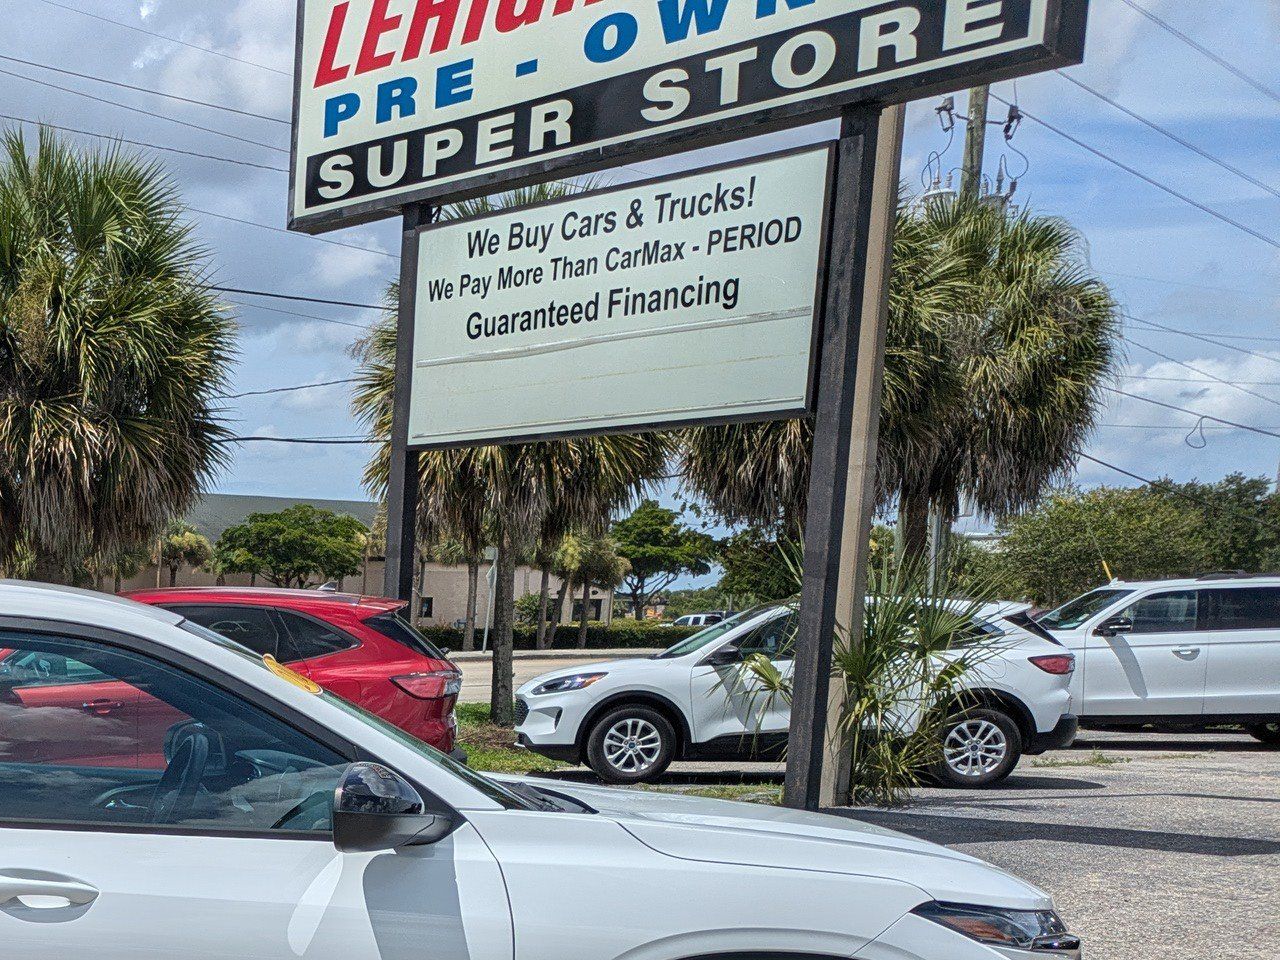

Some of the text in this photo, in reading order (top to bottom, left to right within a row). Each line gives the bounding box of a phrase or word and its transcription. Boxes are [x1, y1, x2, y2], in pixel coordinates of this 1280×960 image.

[313, 0, 615, 88] LEHI
[317, 0, 1005, 199] SUPER STORE
[323, 58, 474, 138] PRE
[428, 278, 454, 302] We
[459, 273, 492, 299] Pay
[497, 264, 543, 290] More
[550, 254, 598, 281] Than
[605, 240, 685, 271] CarMax
[707, 215, 802, 256] PERIOD
[467, 176, 757, 258] We Buy Cars & Trucks!
[466, 277, 740, 340] Guaranteed Financing
